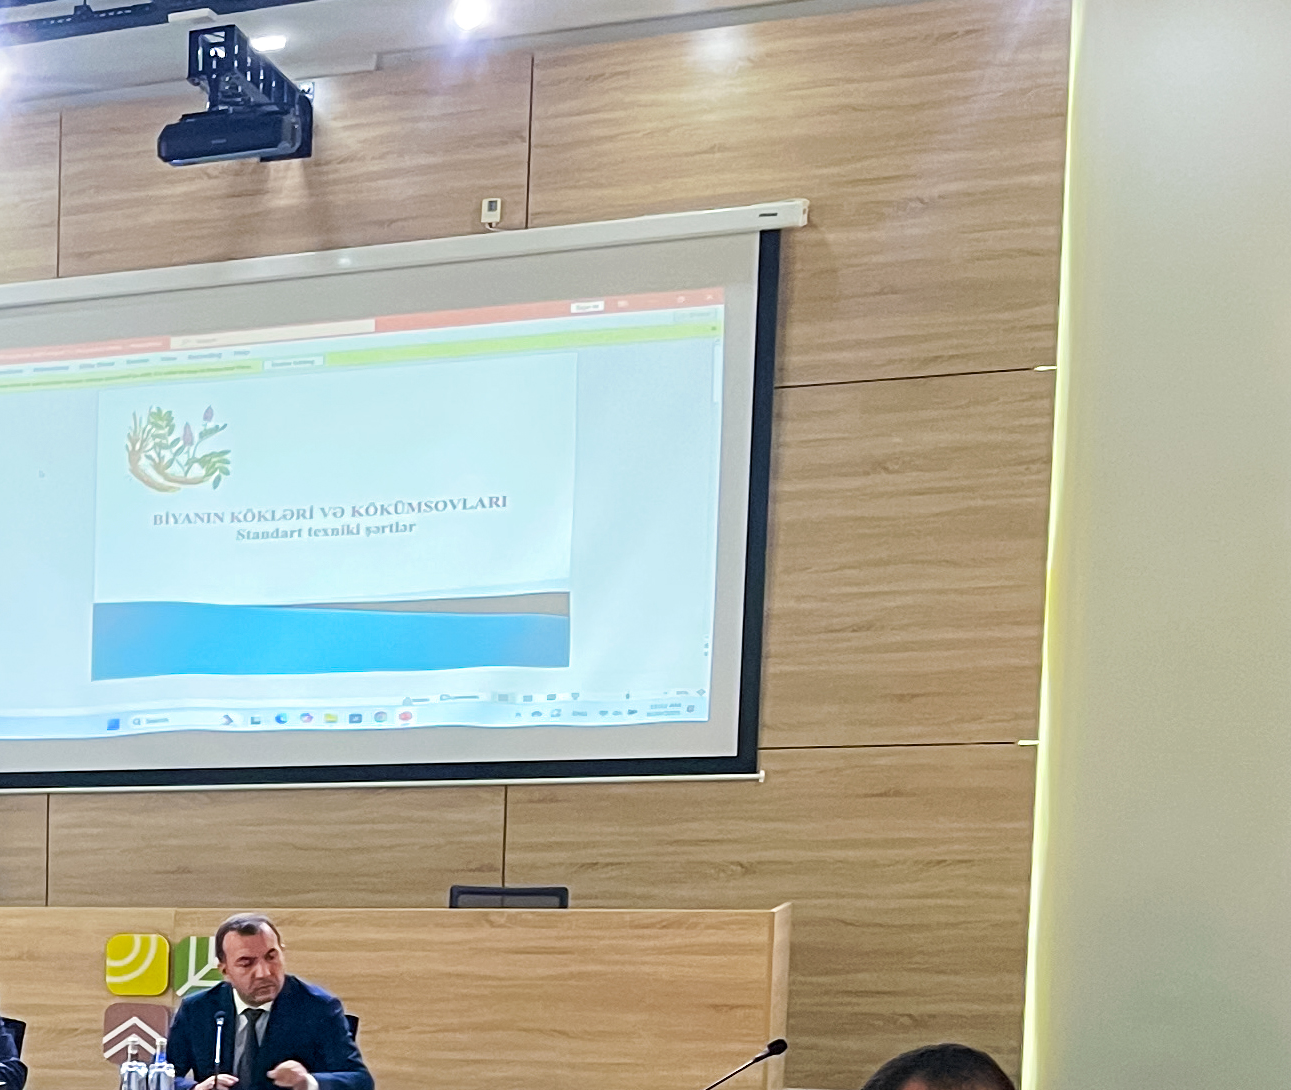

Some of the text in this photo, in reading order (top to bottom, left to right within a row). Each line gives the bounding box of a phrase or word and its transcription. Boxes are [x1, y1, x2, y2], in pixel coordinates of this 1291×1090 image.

[319, 506, 346, 519] VƏ
[235, 521, 417, 541] Standart texniki şərtlər
